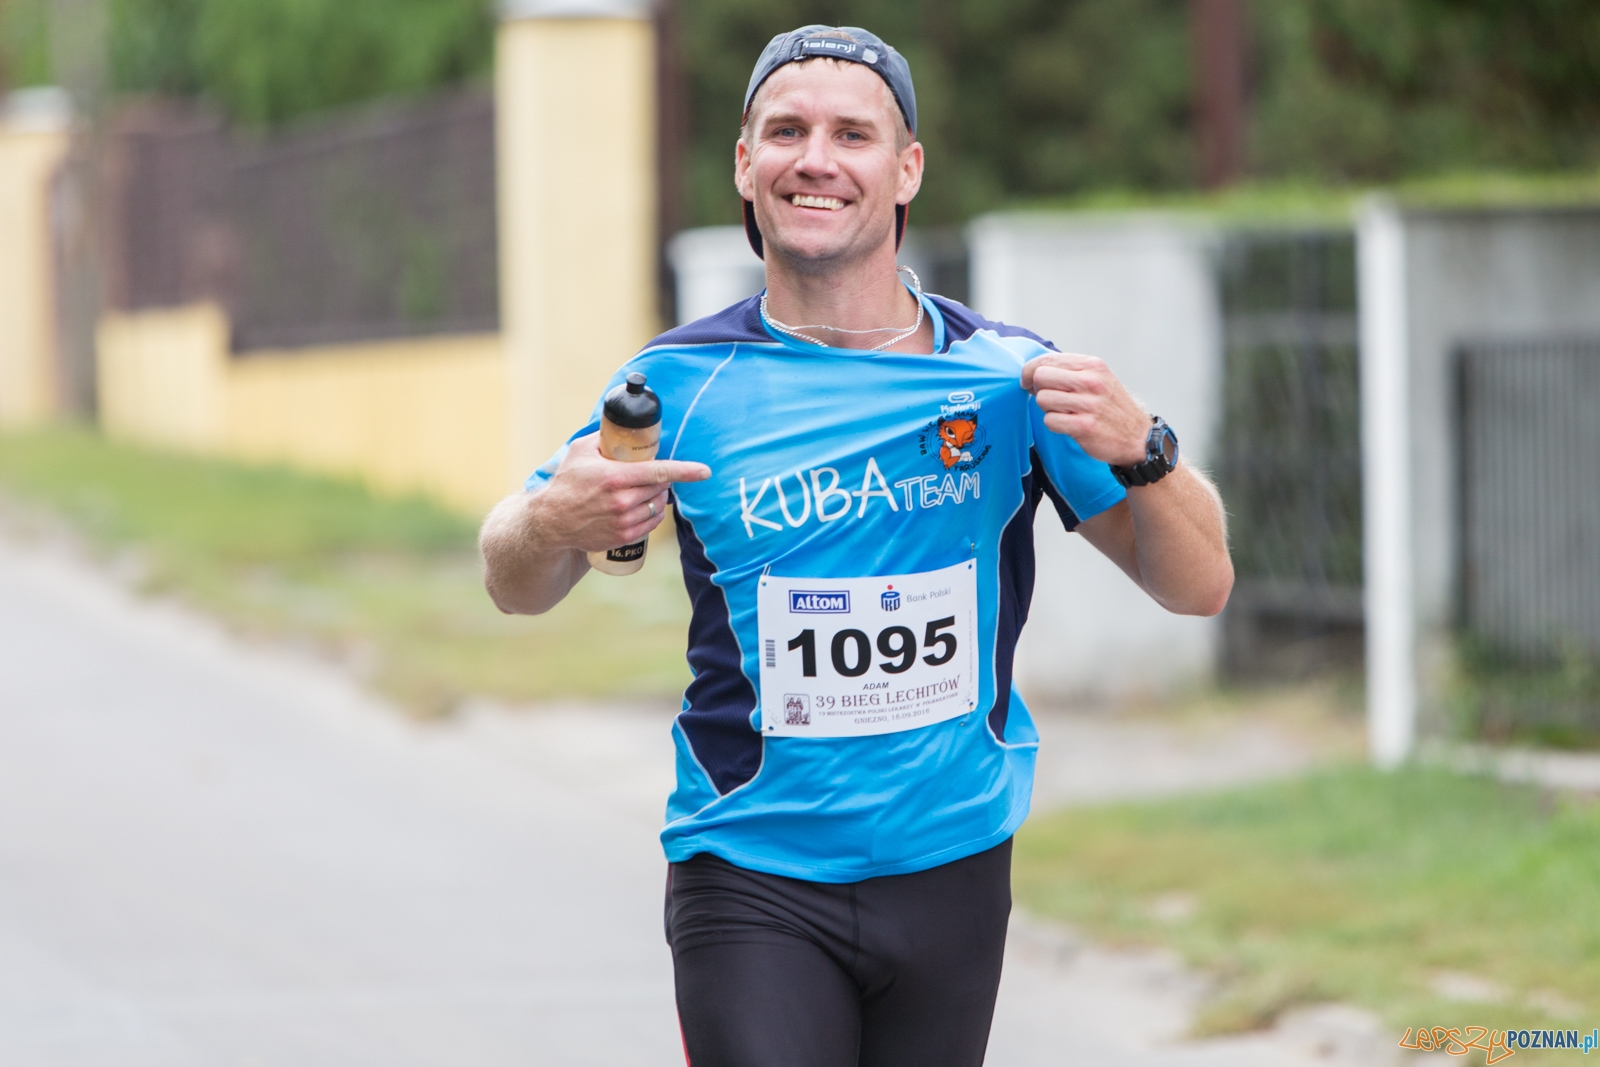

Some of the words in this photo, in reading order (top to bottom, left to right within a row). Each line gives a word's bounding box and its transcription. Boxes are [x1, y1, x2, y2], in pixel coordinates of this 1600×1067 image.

[740, 456, 900, 539] KUBA
[894, 471, 980, 511] TEAM
[611, 549, 624, 558] 16.
[625, 546, 643, 557] PKO
[906, 592, 928, 603] Bank
[929, 587, 952, 599] Polski
[787, 614, 957, 678] 1095
[815, 695, 836, 710] 39
[841, 693, 881, 708] BIEG
[886, 674, 961, 704] LECHITÓW
[862, 681, 889, 691] ADAM
[867, 706, 887, 714] POLSKI
[888, 703, 914, 712] LEKARZY
[854, 714, 889, 724] GNIEZNO,
